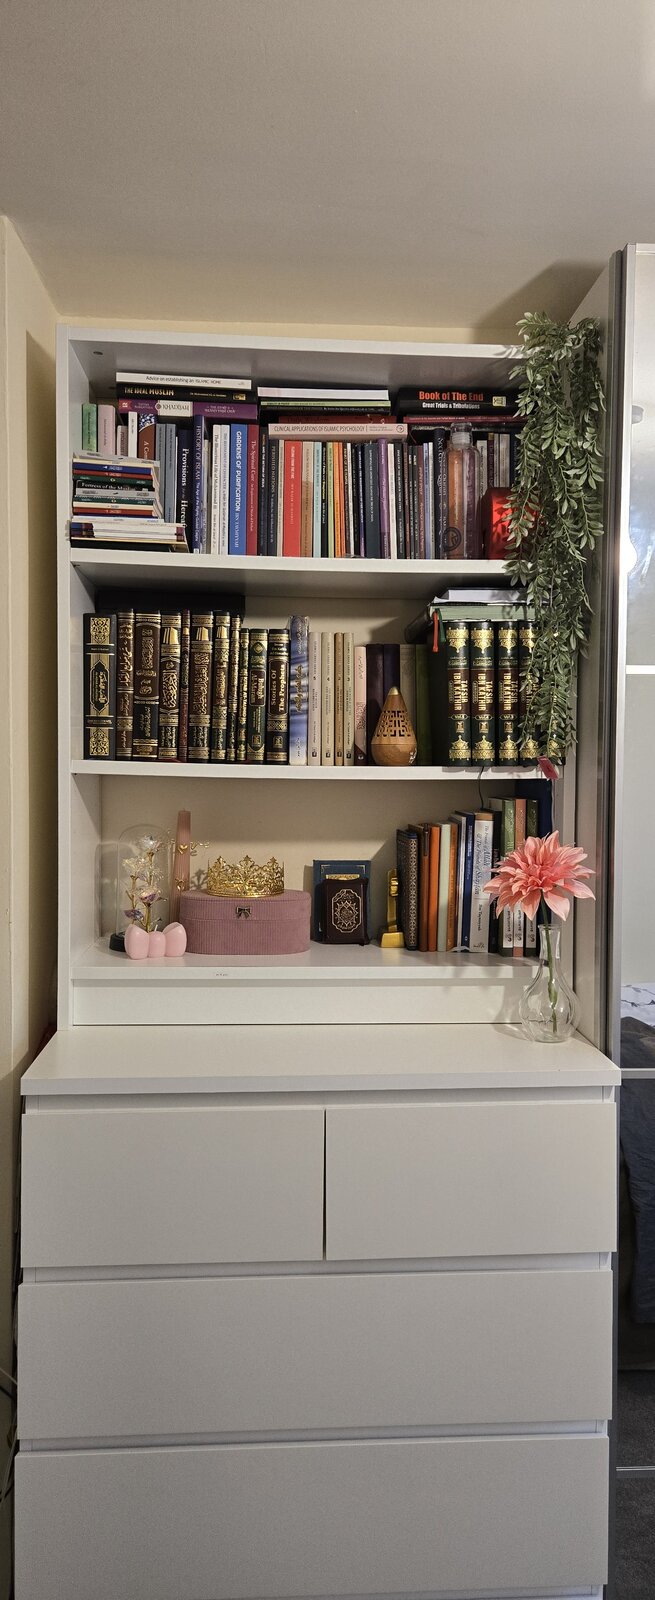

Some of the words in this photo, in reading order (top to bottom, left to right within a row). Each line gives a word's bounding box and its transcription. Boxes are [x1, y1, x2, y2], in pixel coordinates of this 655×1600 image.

[419, 391, 440, 400] Book
[442, 392, 450, 400] of
[452, 392, 467, 400] The
[469, 392, 484, 401] End
[195, 452, 201, 461] OF
[181, 448, 190, 486] Provisions
[236, 460, 241, 469] OF
[180, 500, 188, 528] Hereaf
[271, 670, 277, 679] Of
